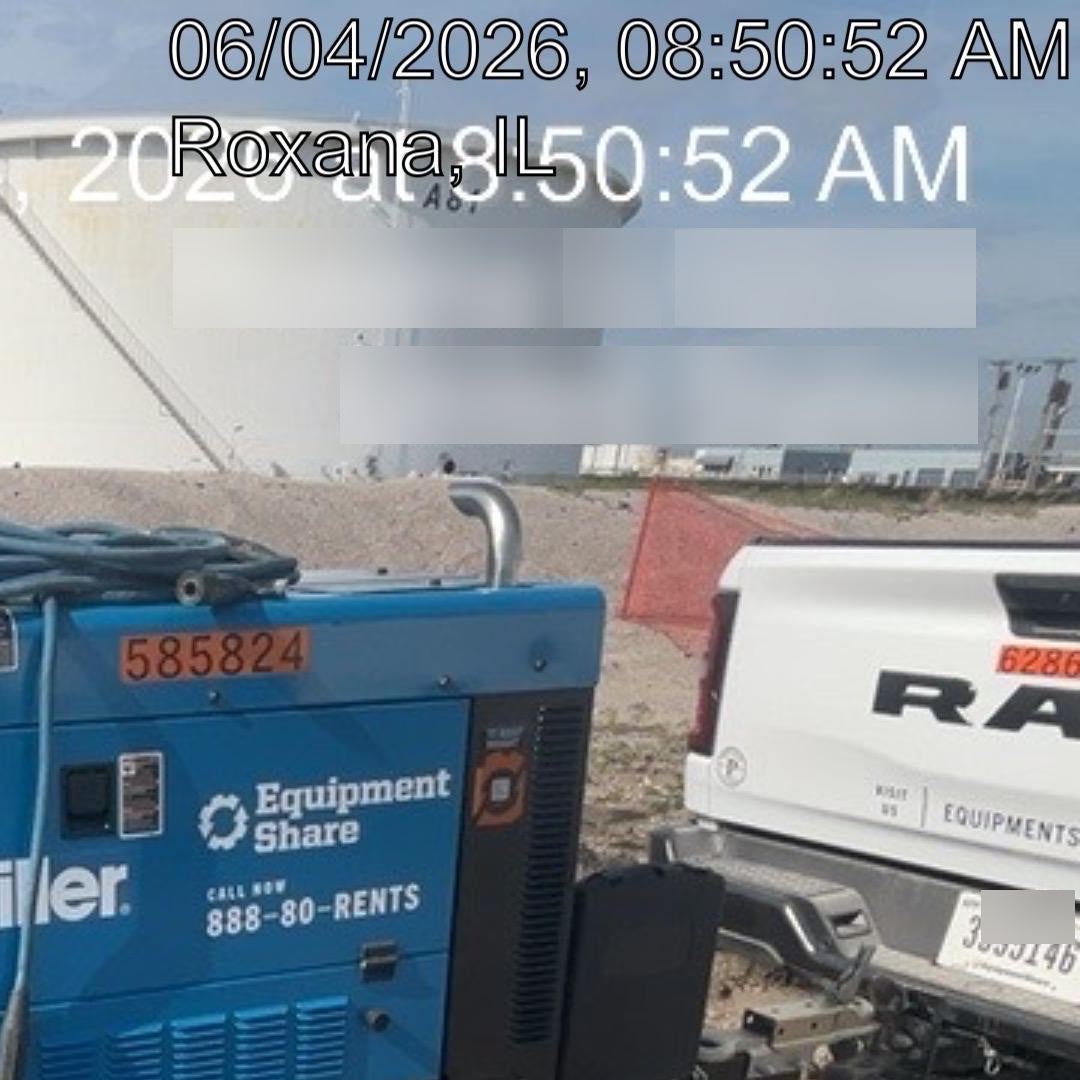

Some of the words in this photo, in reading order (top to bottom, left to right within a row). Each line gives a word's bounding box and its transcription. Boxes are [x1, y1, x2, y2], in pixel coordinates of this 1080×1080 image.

[126, 630, 305, 681] 585824
[254, 768, 452, 820] Equipment
[254, 820, 361, 853] Share
[206, 886, 245, 902] CALL
[251, 879, 287, 898] NOW
[206, 883, 421, 938] 888-80-RENTS
